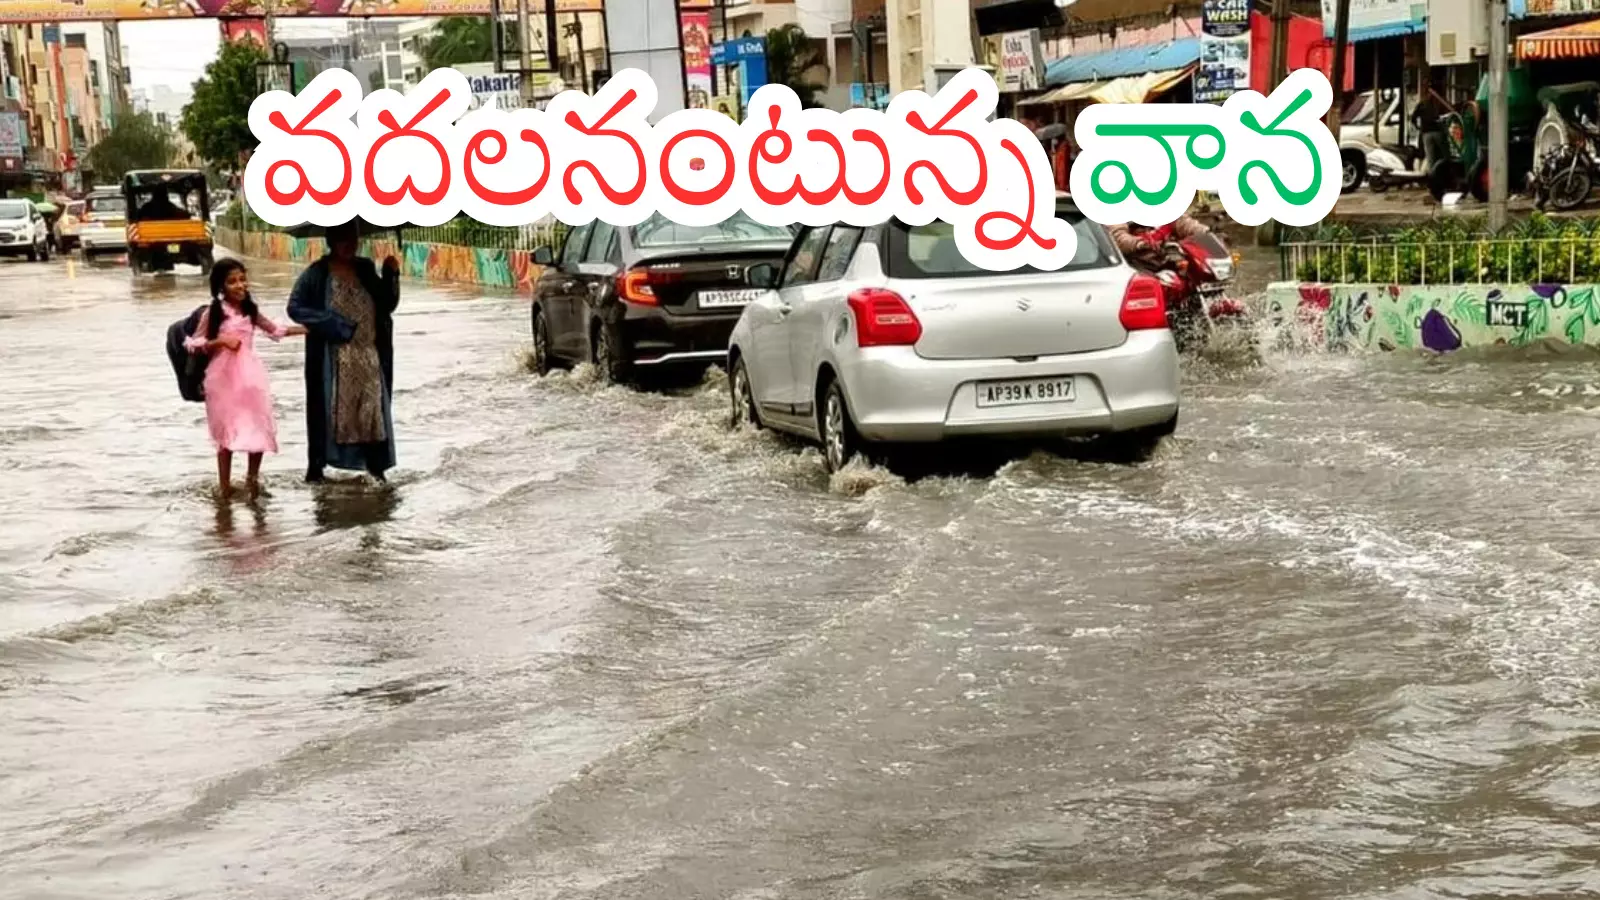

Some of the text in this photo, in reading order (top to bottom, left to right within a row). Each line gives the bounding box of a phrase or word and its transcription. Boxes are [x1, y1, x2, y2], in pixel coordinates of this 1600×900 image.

[1206, 9, 1248, 21] WASH
[1491, 303, 1526, 325] MCT
[1037, 380, 1071, 398] 8917
